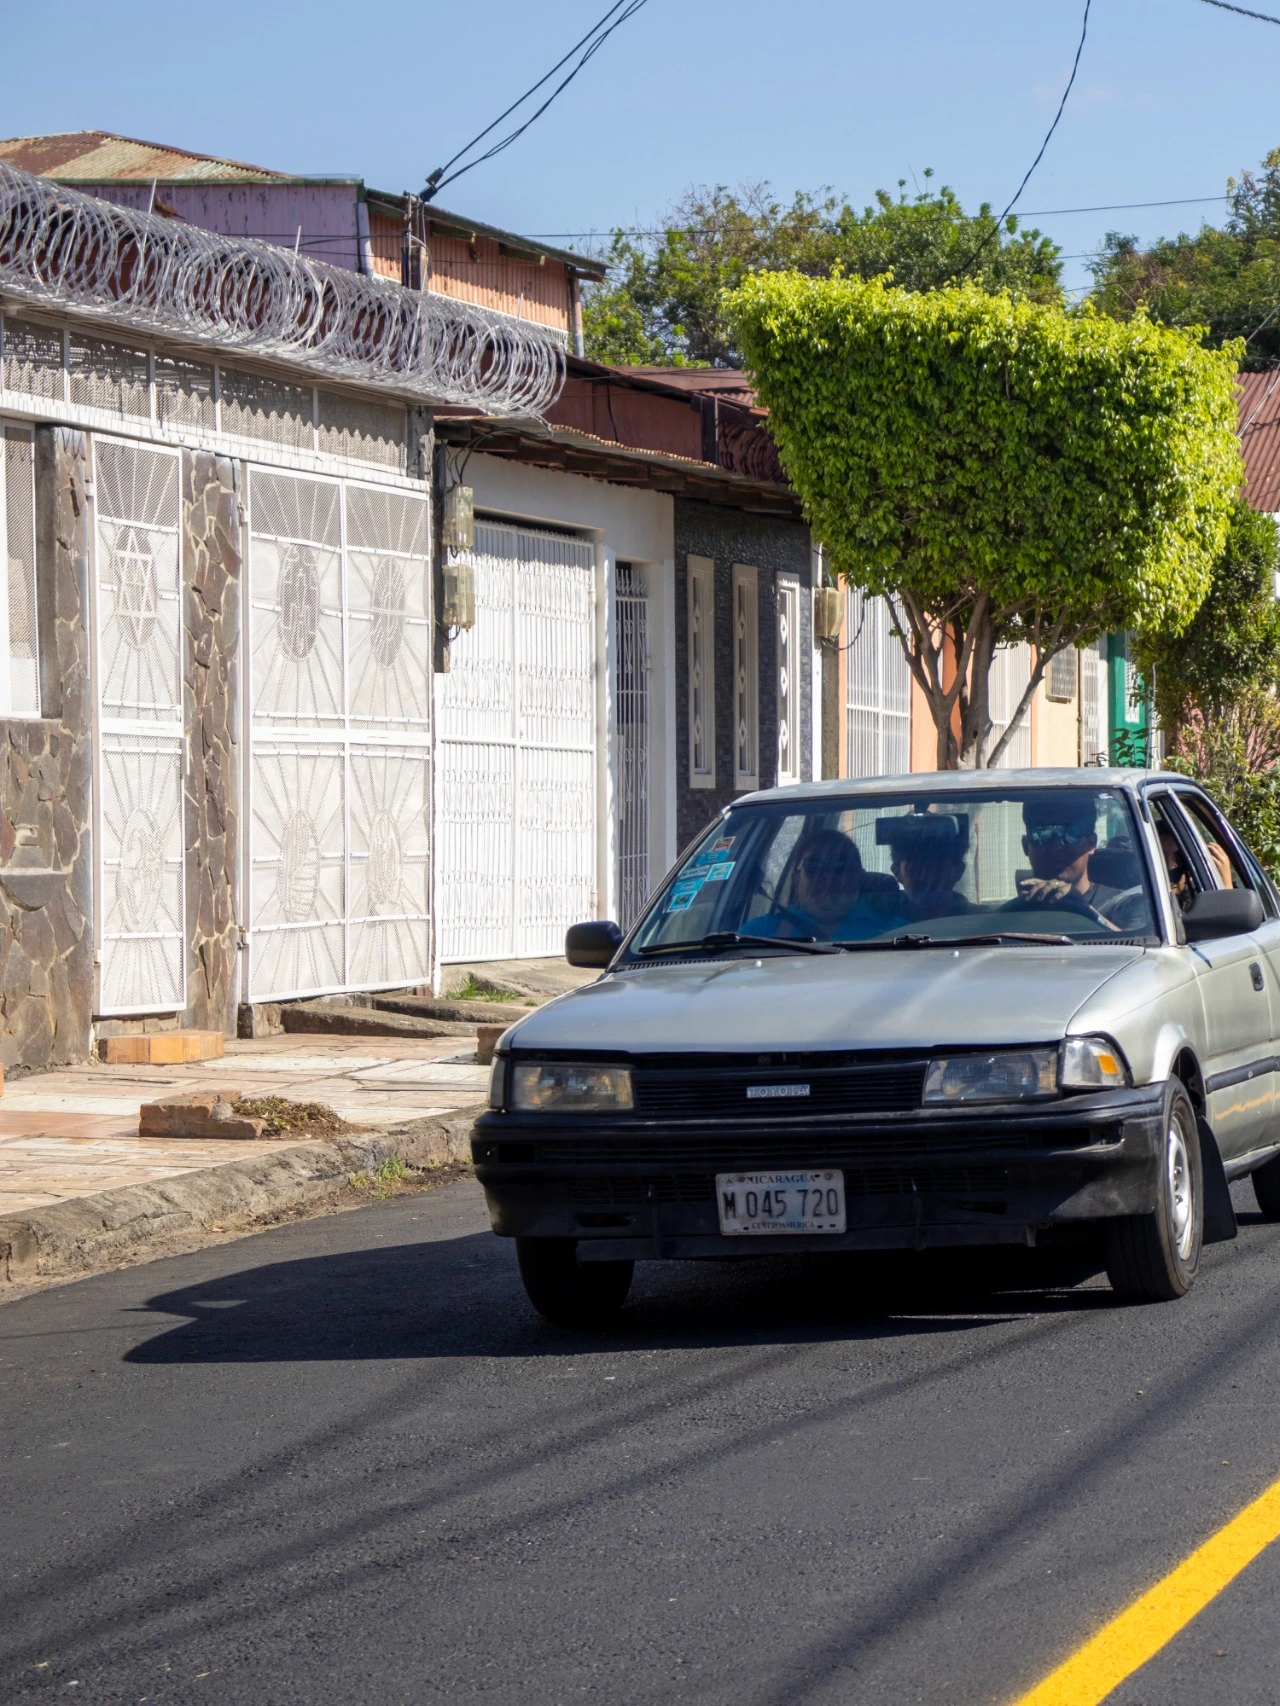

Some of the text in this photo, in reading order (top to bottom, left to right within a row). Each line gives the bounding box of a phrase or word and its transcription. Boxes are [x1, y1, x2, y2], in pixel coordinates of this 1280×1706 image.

[750, 1085, 807, 1098] TOYOTA
[746, 1173, 816, 1185] NICARAGUA
[722, 1188, 839, 1219] M 045 720
[752, 1221, 815, 1230] CENTROAMERICA
